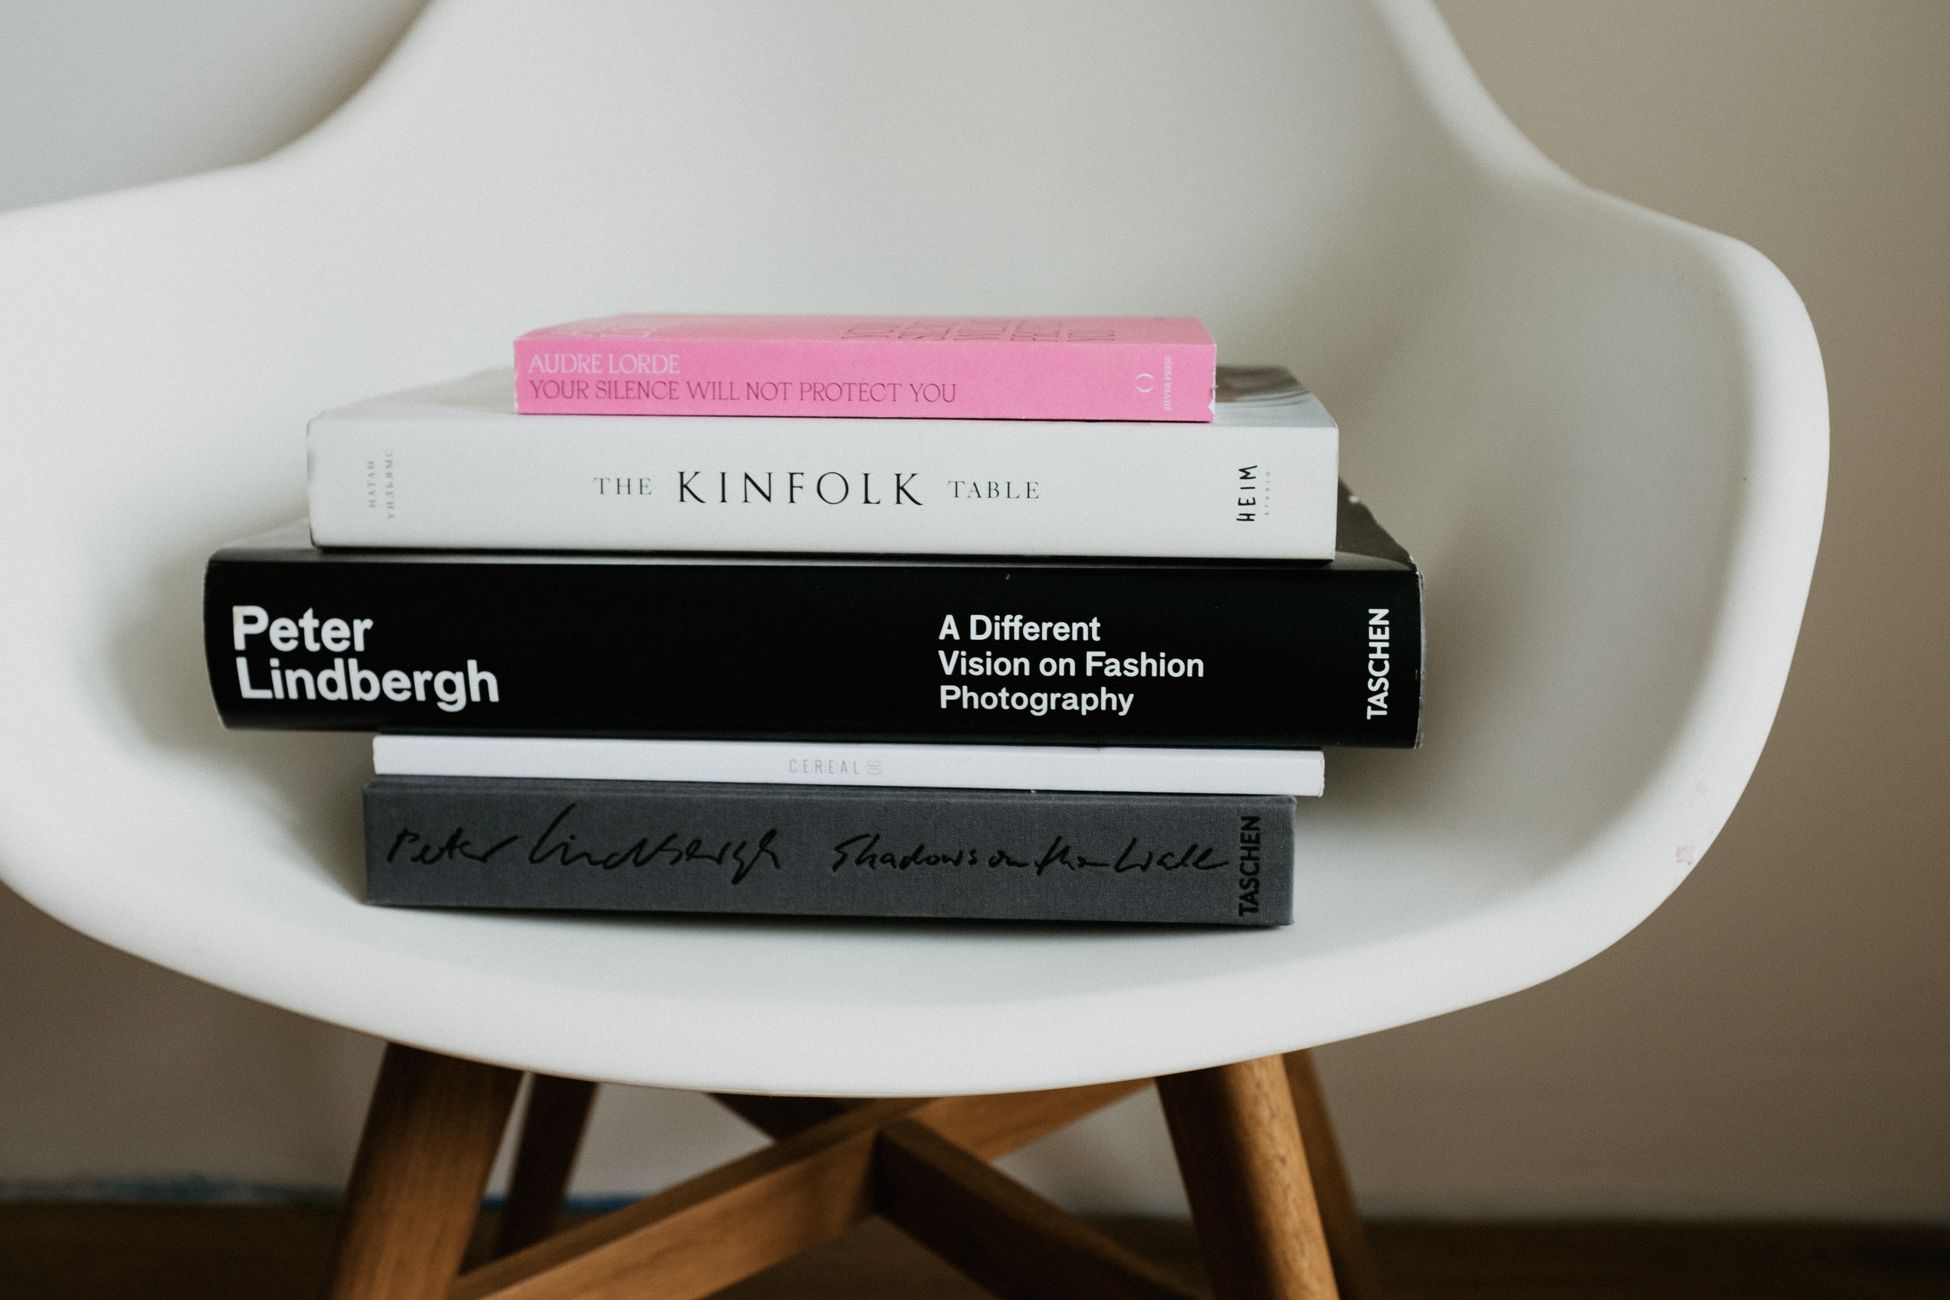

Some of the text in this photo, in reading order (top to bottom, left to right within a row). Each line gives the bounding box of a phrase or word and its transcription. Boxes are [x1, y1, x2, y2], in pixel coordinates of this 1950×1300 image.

[529, 354, 680, 374] AUDRE LORDE
[529, 380, 957, 403] YOUR SILENCE WILL NOT PROTECT YOU
[593, 471, 1040, 506] THE KINFOLK TABLE
[1236, 465, 1258, 521] HEIM
[232, 605, 374, 652] Peter
[938, 614, 1101, 641] A Different
[938, 650, 1204, 677] Vision on Fashion
[1366, 608, 1390, 720] TASCHEN
[236, 656, 499, 712] Lindbergh
[940, 684, 1134, 716] Photography
[788, 758, 859, 775] CEREAL
[387, 827, 519, 866] Peter
[528, 803, 780, 886] Lindbergh
[831, 833, 979, 872] Shadows
[988, 849, 1029, 873] on
[1238, 815, 1262, 916] TASCHEN
